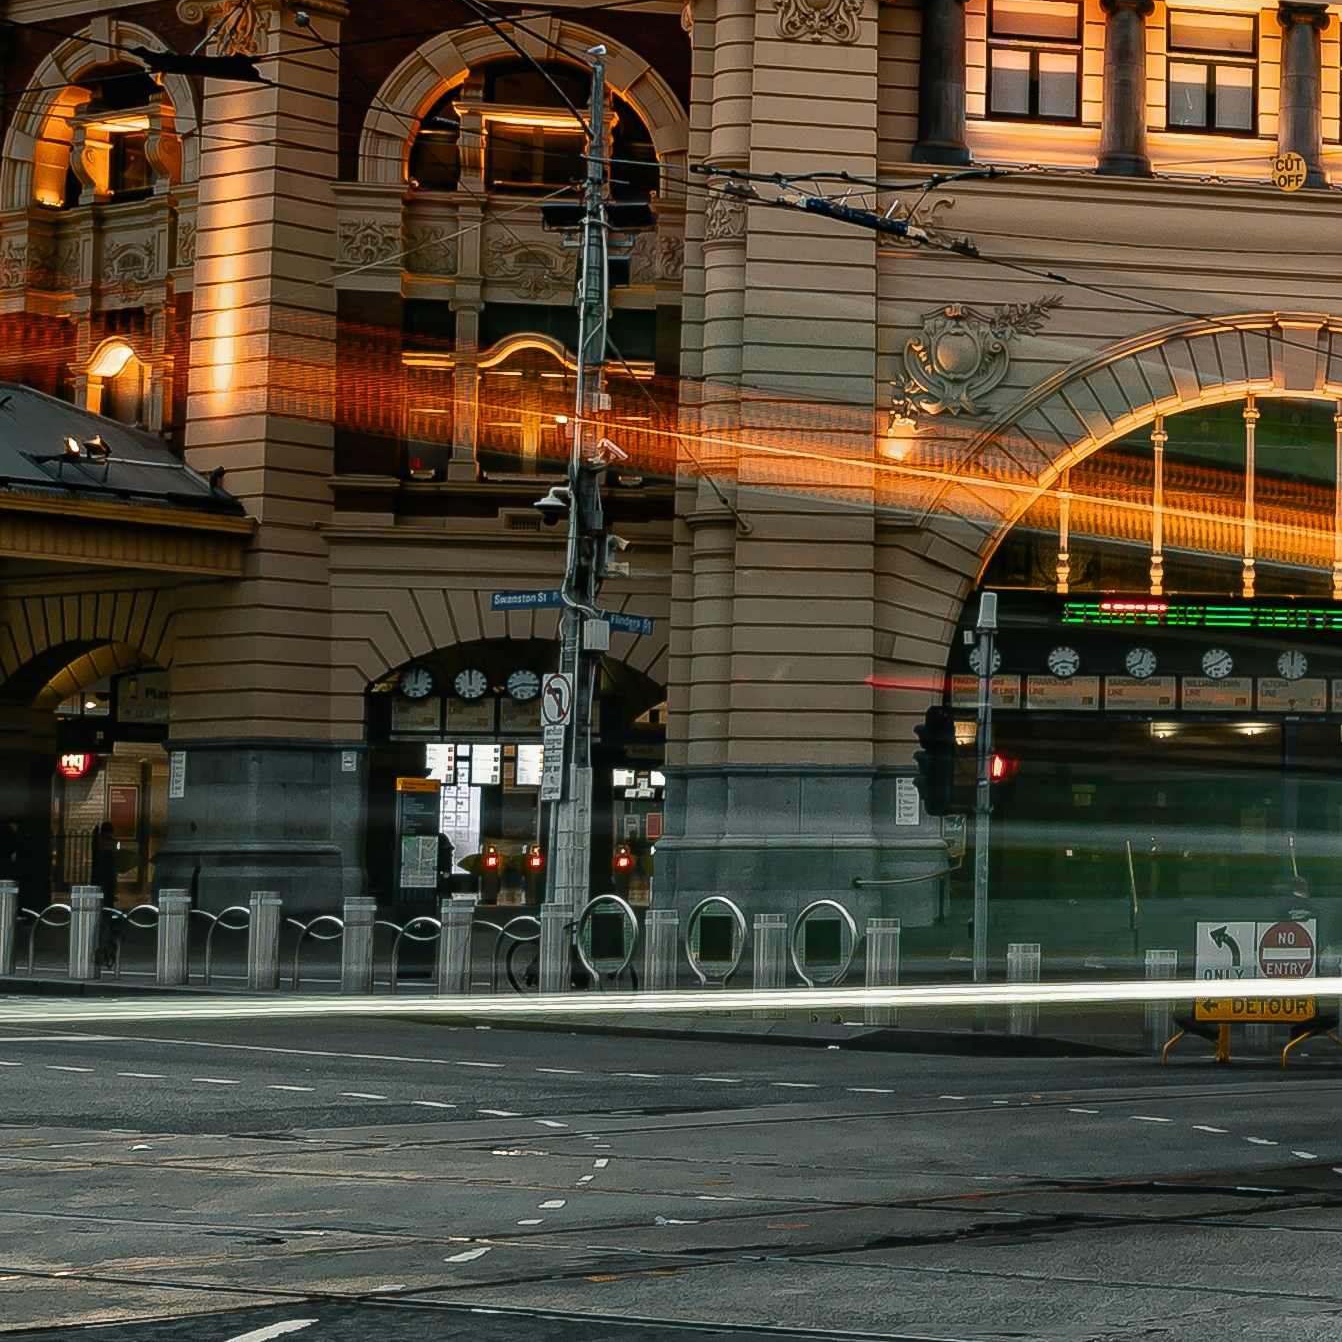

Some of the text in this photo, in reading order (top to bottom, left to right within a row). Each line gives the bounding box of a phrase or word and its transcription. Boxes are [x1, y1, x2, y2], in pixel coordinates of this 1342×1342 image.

[1275, 158, 1302, 172] CUT
[1277, 173, 1304, 188] OFF
[494, 594, 537, 605] Swanston
[537, 592, 547, 603] St
[1277, 932, 1295, 945] NO
[1203, 968, 1245, 980] ONLY
[1266, 962, 1306, 975] ENTRY
[1232, 998, 1308, 1014] DETOUR
